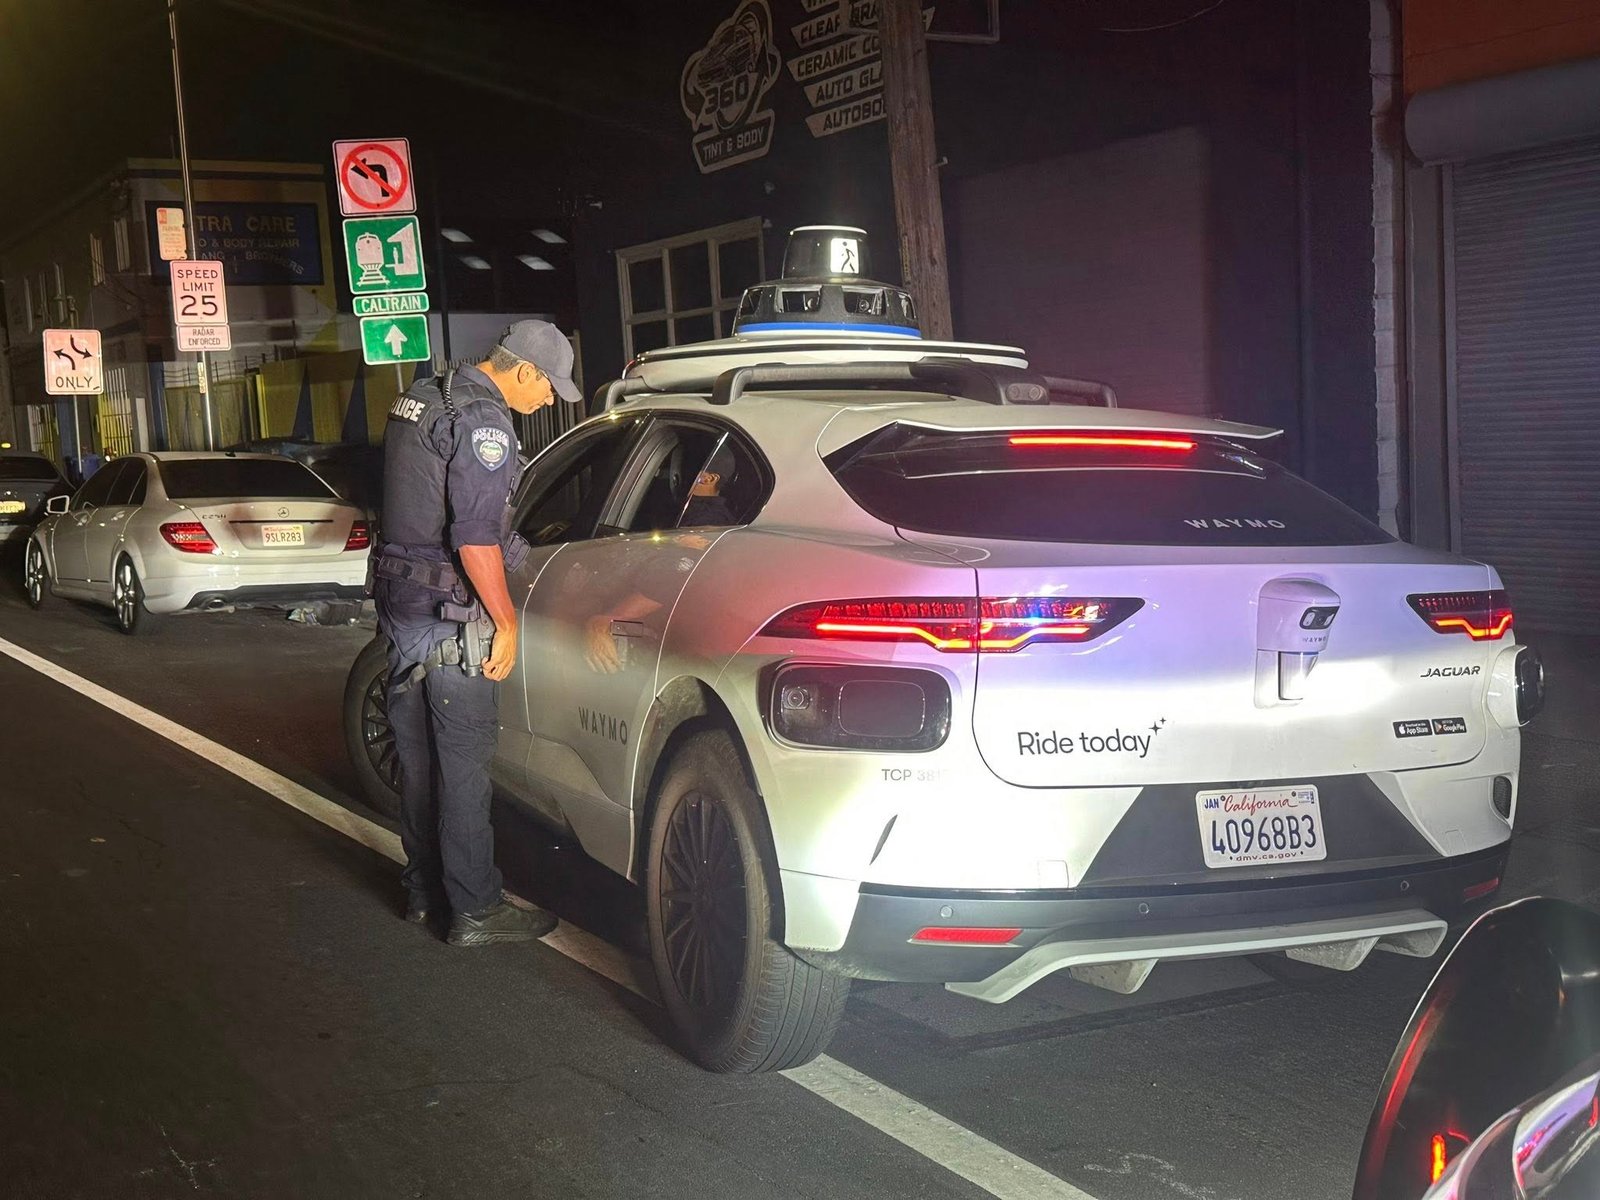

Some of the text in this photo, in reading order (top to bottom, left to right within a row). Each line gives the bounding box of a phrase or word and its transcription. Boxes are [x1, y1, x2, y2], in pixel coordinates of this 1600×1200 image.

[798, 43, 857, 77] CERAMIC
[704, 74, 749, 115] 360
[816, 75, 853, 103] AUTO
[703, 126, 764, 161] TINT & BODY
[195, 215, 233, 232] TRA
[246, 215, 297, 233] CARE
[177, 269, 218, 279] SPEED
[182, 282, 214, 292] LIMIT
[180, 294, 218, 316] 25
[361, 296, 421, 313] CALTRAIN
[192, 328, 215, 336] RADAR
[188, 337, 221, 346] ENFORCED
[55, 376, 93, 388] ONLY
[1184, 519, 1287, 529] WAYMO
[265, 531, 302, 543] 9SLR283
[1420, 666, 1481, 678] JAGUAR
[578, 705, 629, 745] WAYMO
[1017, 728, 1151, 758] Ride today
[881, 769, 913, 782] TCP
[1204, 798, 1220, 809] JAN
[1224, 793, 1298, 816] California
[1211, 815, 1317, 854] 40968B3
[1236, 852, 1298, 861] dmv.ca.gov
